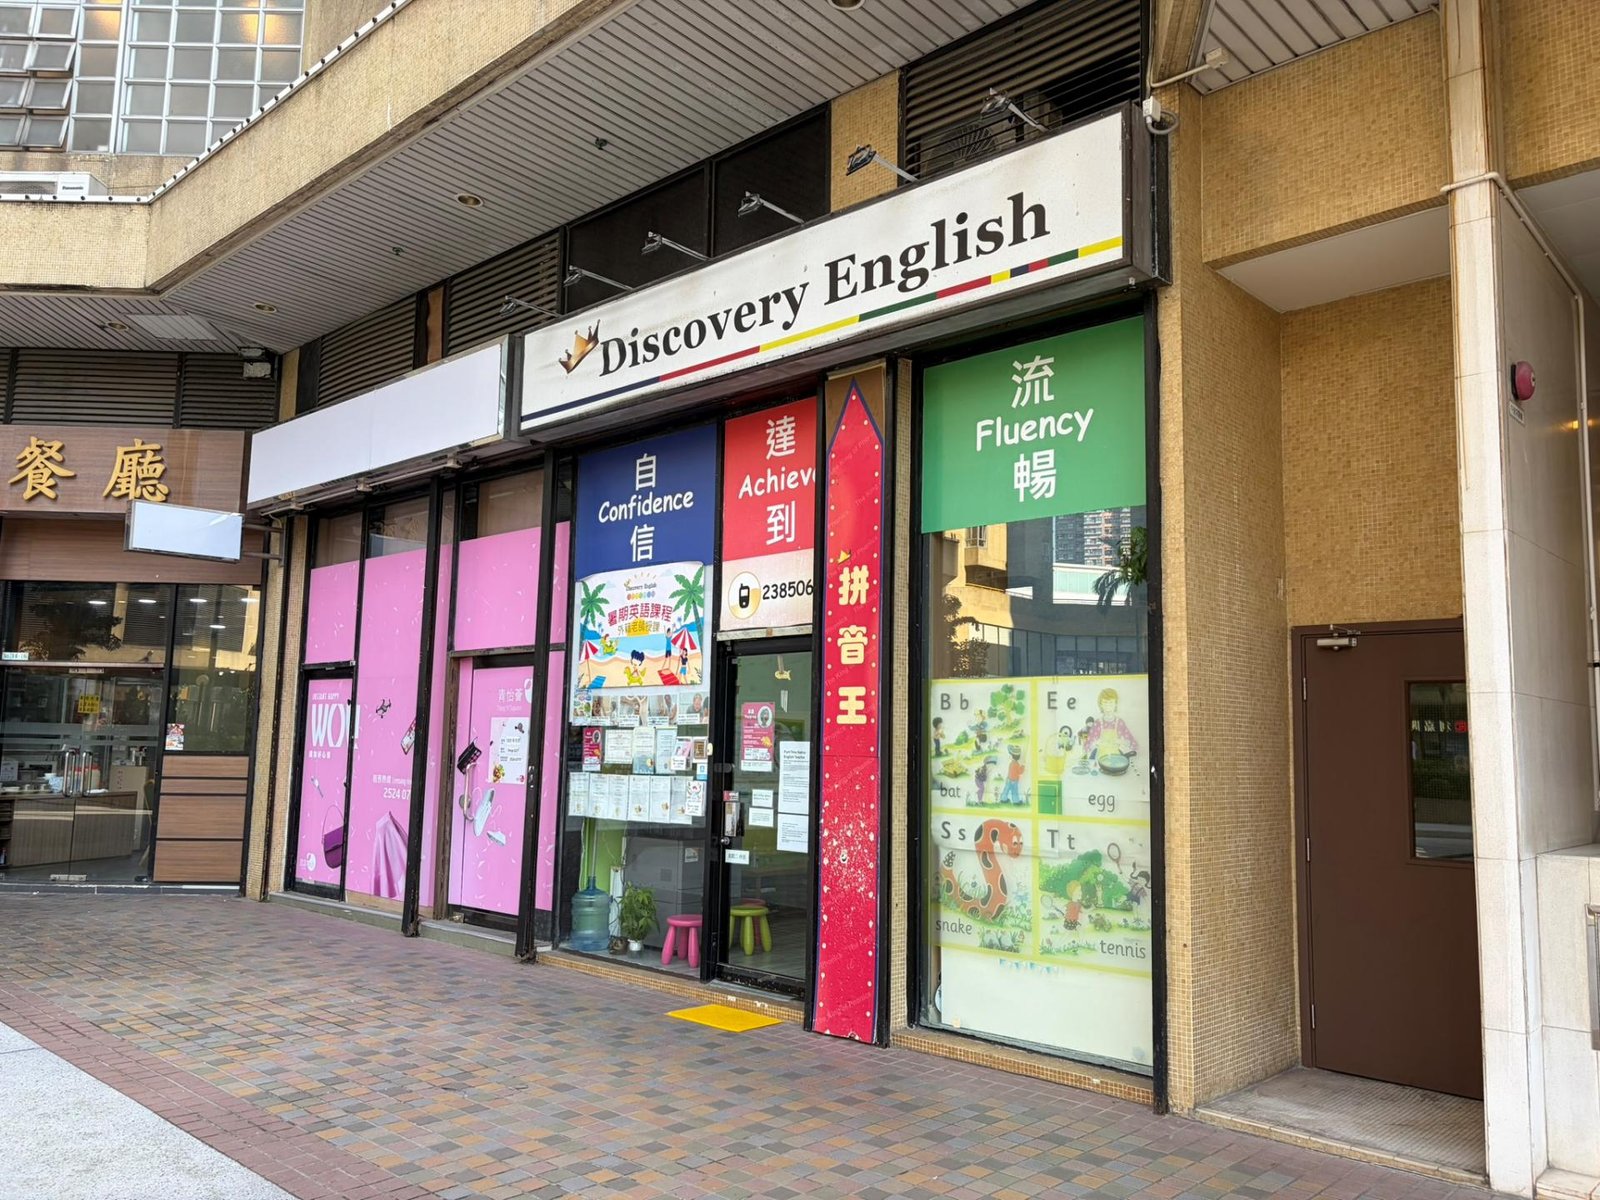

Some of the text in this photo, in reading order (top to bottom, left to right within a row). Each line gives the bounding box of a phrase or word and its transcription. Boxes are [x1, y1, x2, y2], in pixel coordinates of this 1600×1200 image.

[599, 191, 1050, 377] Discovery English
[1010, 355, 1055, 408] 流
[765, 415, 796, 460] 達
[975, 408, 1094, 452] Fluency
[8, 436, 171, 502] 餐廳
[635, 453, 656, 491] 自
[1013, 449, 1056, 502] 暢
[598, 491, 694, 523] Confidence
[766, 500, 796, 545] 到
[630, 523, 655, 562] 信
[762, 579, 814, 601] 238506
[608, 602, 673, 626] 暑期英語課程
[836, 564, 870, 725] 拼音王
[940, 693, 969, 711] B b
[1047, 691, 1076, 710] E e
[939, 783, 961, 799] bat
[1088, 792, 1116, 812] egg
[940, 821, 966, 841] S s
[1047, 829, 1076, 850] T t
[935, 919, 973, 936] snake
[1099, 939, 1146, 960] tennis
